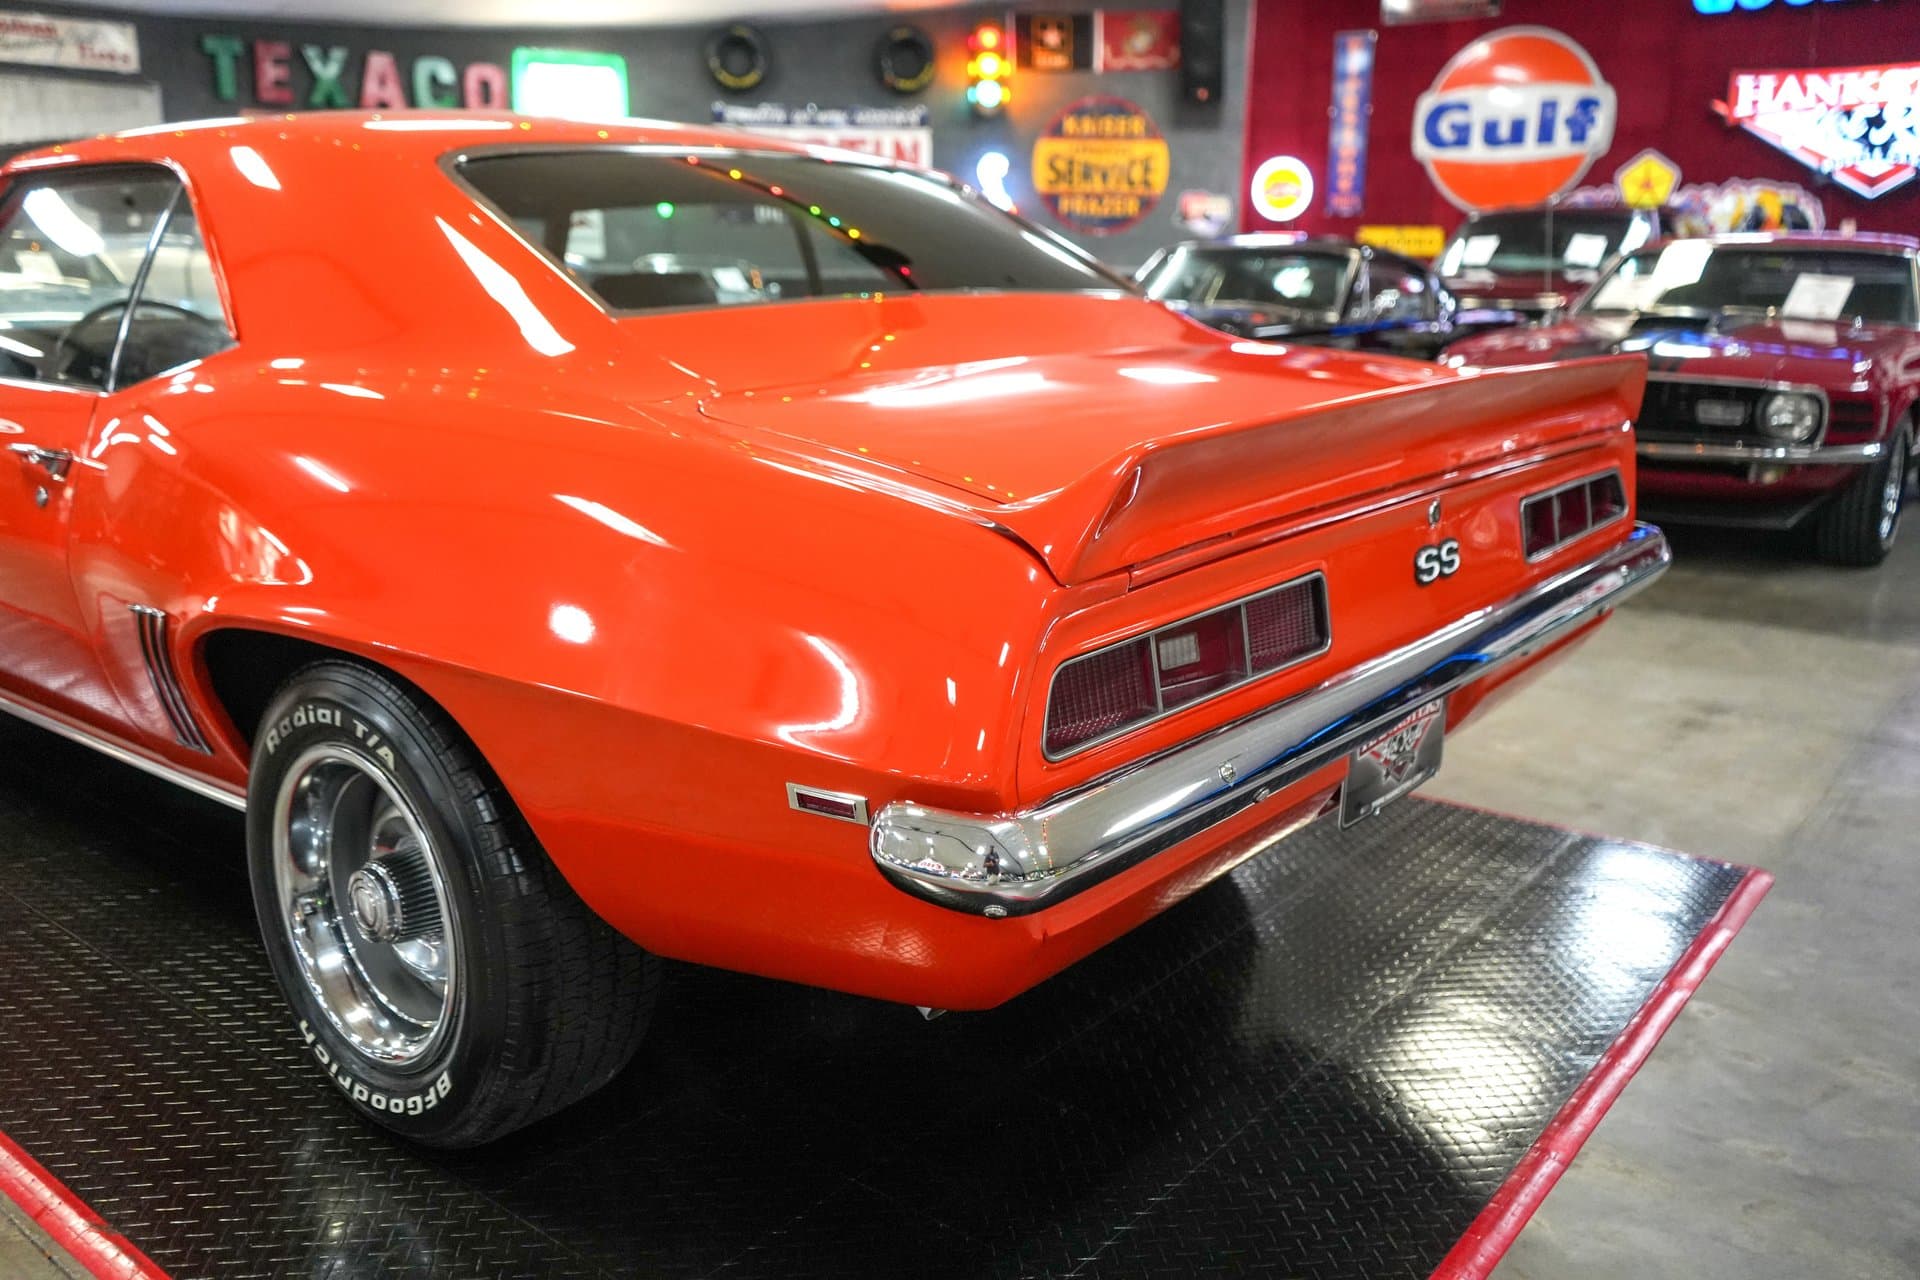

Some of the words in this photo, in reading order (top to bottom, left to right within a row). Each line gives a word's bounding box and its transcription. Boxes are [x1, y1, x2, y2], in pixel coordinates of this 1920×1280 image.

[202, 34, 507, 109] TEXACO
[1424, 97, 1600, 148] Gulf
[1047, 154, 1154, 187] SERVICE
[1414, 538, 1461, 585] SS
[264, 704, 342, 756] Radial
[353, 718, 397, 772] T/A
[299, 1019, 454, 1117] BFGoodrich
